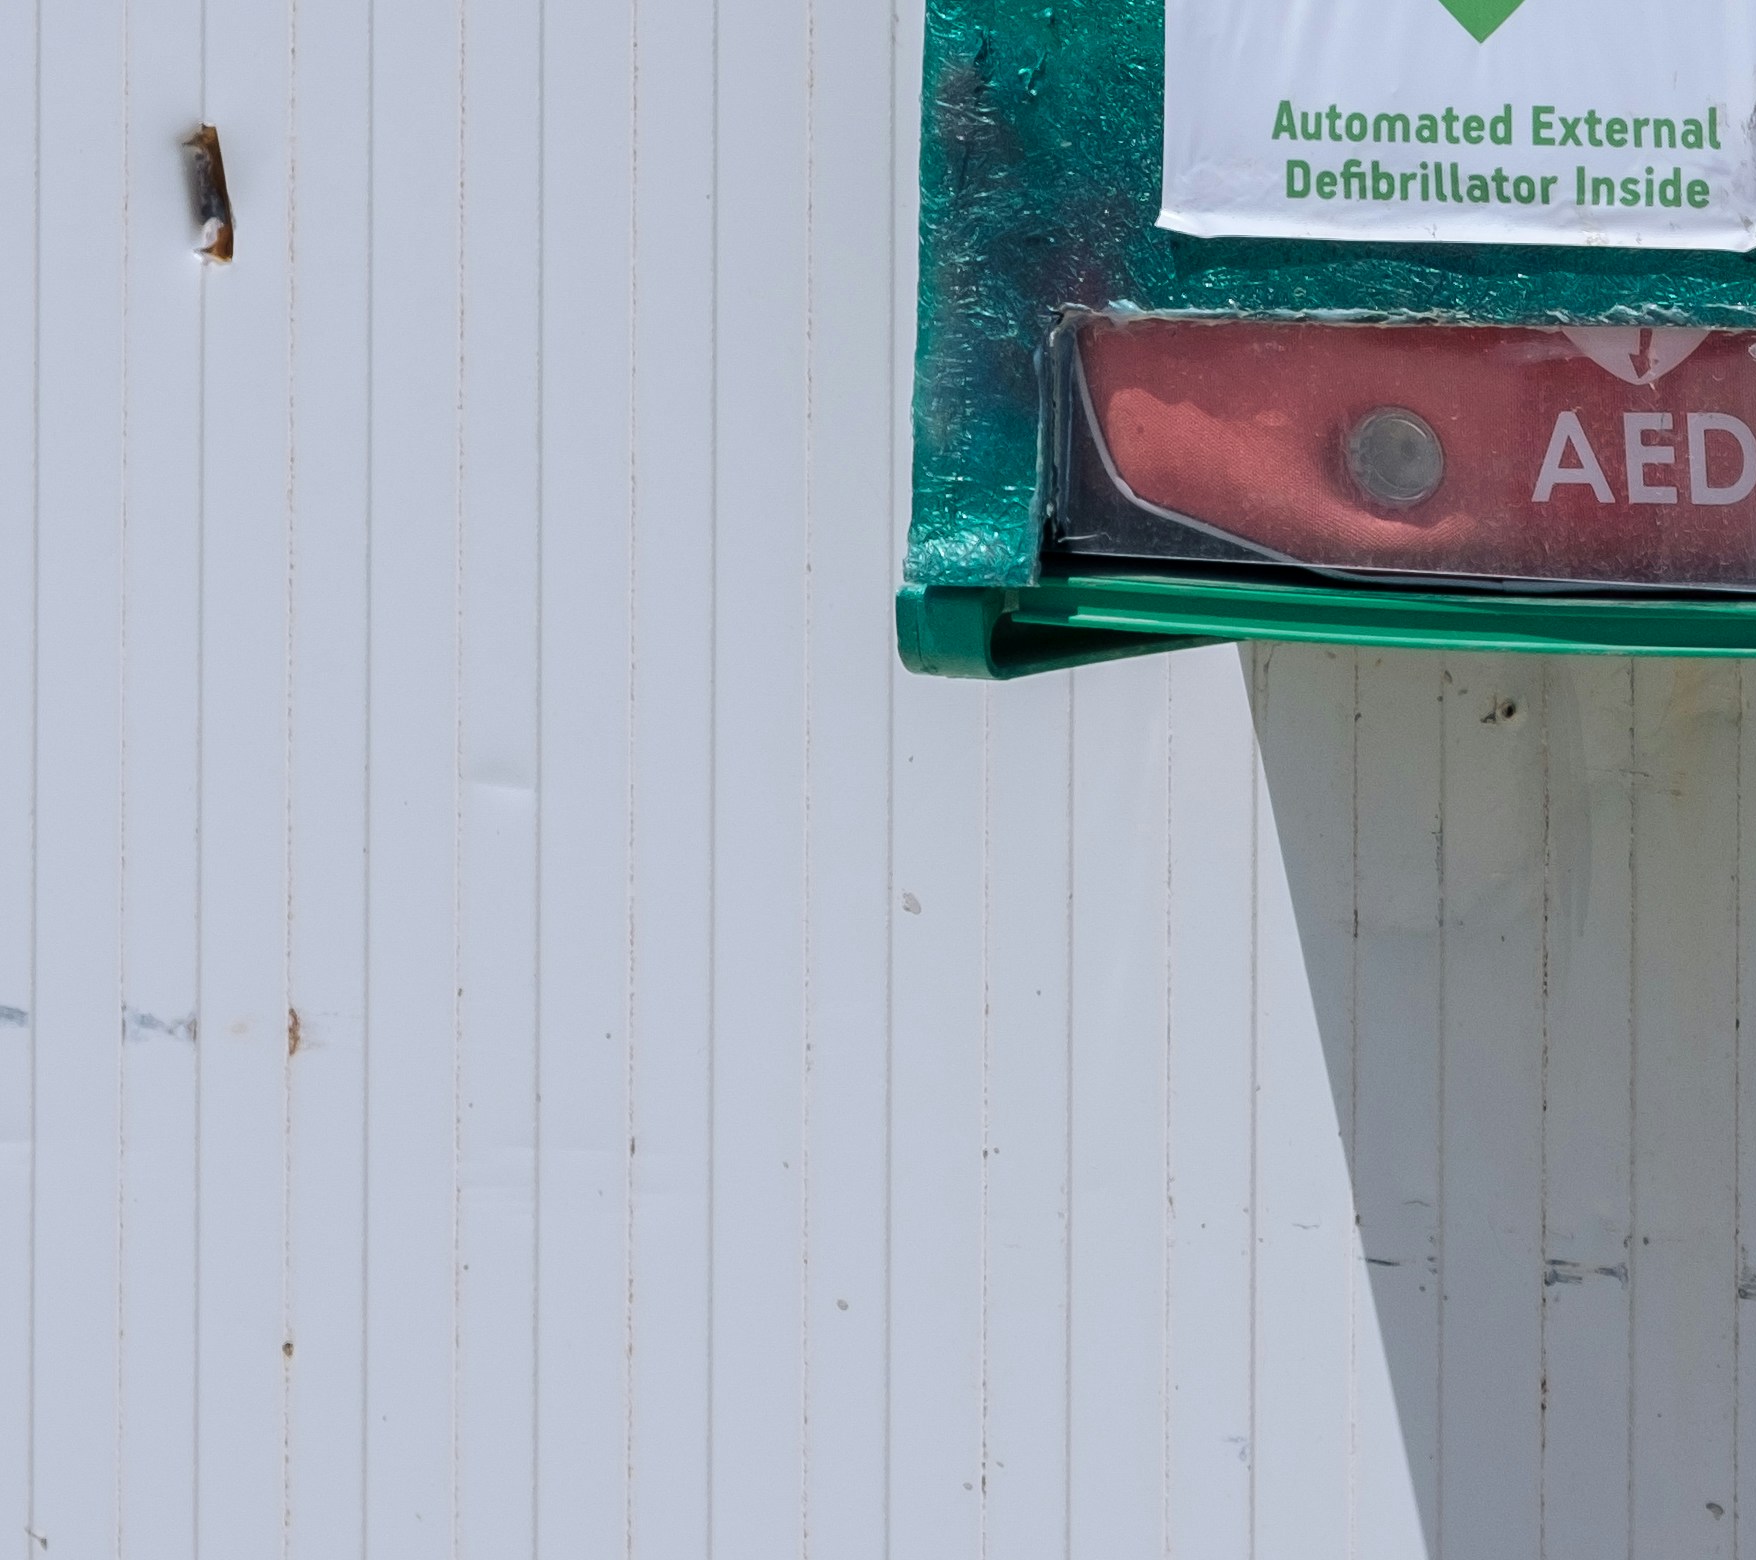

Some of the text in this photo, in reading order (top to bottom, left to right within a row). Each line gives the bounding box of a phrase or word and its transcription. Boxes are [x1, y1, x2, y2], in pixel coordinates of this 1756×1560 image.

[1271, 99, 1722, 152] Automated External
[1285, 158, 1711, 210] Defibrillator Inside
